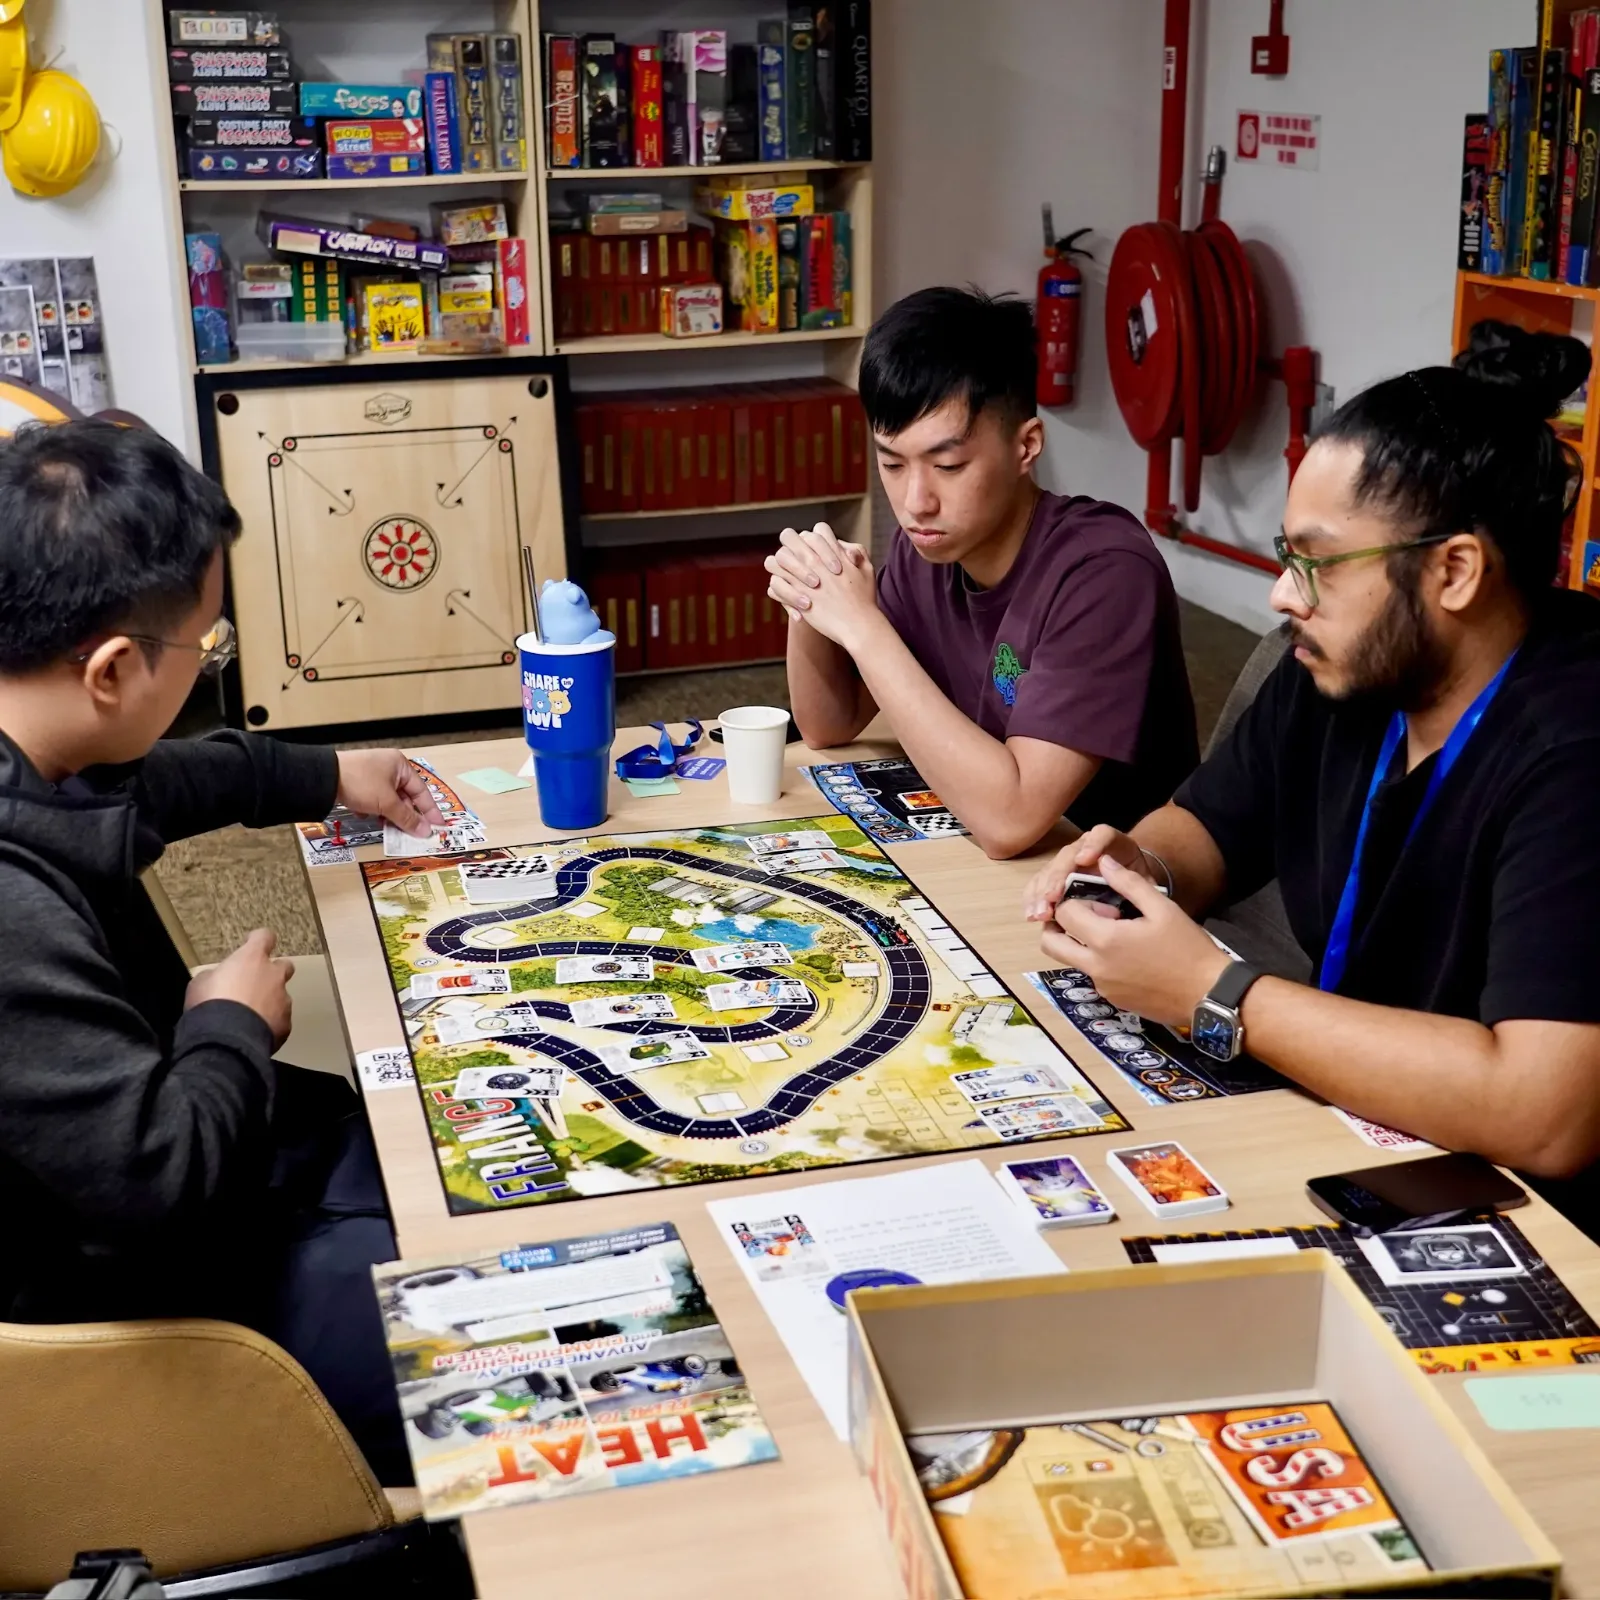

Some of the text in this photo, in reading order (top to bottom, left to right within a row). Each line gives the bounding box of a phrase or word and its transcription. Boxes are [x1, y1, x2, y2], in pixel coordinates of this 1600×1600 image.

[524, 671, 560, 690] SHARE
[527, 709, 562, 728] LOVE
[436, 1342, 521, 1367] SYSTEM
[476, 1341, 648, 1380] ADVANCED PLAY
[488, 1413, 709, 1487] HEAT
[1221, 1411, 1375, 1530] USA
